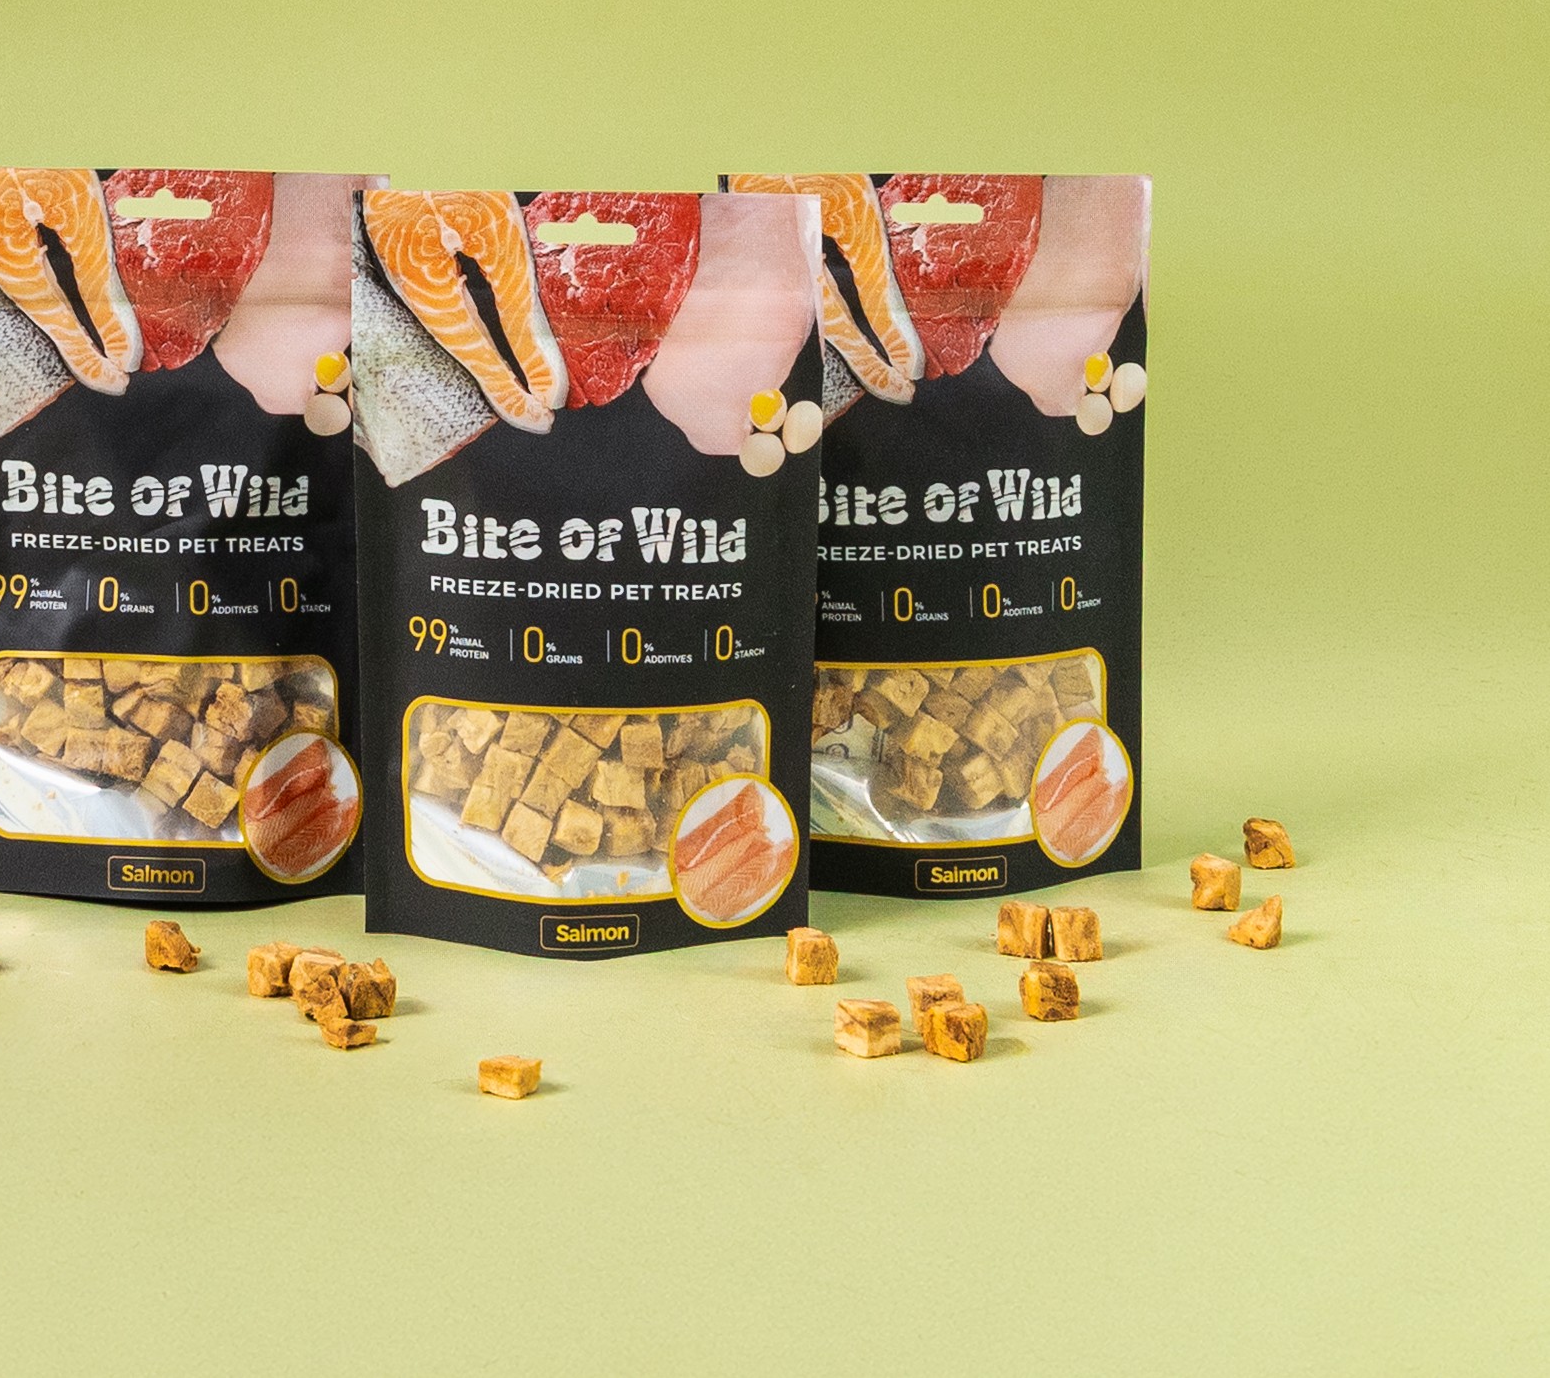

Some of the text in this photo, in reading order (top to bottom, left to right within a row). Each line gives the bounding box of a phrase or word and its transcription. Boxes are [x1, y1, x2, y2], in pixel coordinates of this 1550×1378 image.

[2, 460, 308, 518] Bite of Wild
[924, 482, 980, 522] of
[987, 469, 1082, 521] Wild
[421, 498, 746, 563] Bite of Wild
[12, 533, 303, 553] FREEZE-DRIED PET TREATS
[818, 536, 1081, 561] REEZE-DRIED PET TREATS
[30, 590, 62, 598] ANIMAL
[431, 576, 742, 600] FREEZE-DRIED PET TREATS
[30, 601, 67, 610] PROTEIN
[119, 604, 154, 613] GRAINS
[212, 605, 258, 614] ADDITIVES
[822, 613, 862, 621] PROTEIN
[915, 613, 949, 621] GRAINS
[450, 637, 484, 648] ANIMAL
[450, 648, 489, 660] PROTEIN
[546, 655, 583, 664] GRAINS
[644, 654, 692, 664] ADDITIVES
[122, 865, 193, 883] Salmon
[931, 867, 998, 883] Salmon
[556, 924, 629, 942] Salmon
